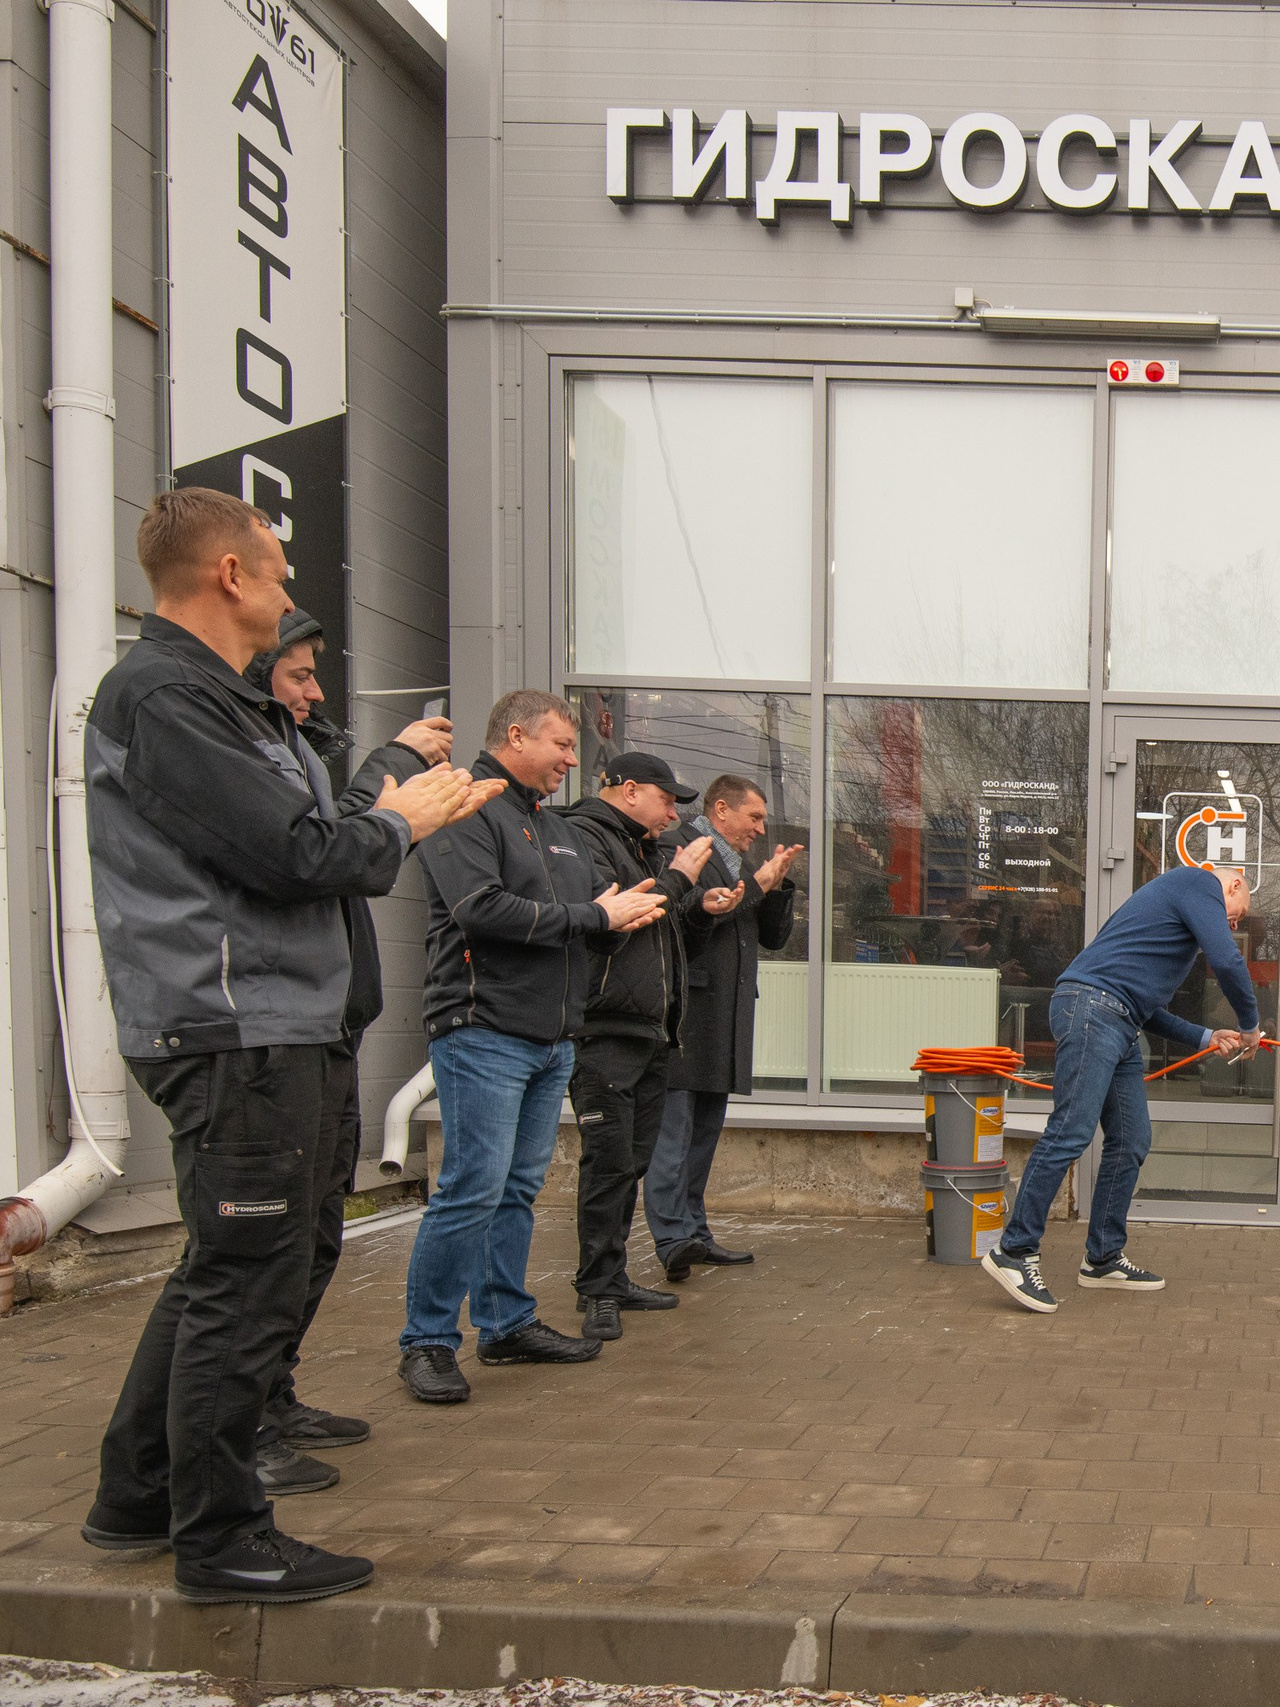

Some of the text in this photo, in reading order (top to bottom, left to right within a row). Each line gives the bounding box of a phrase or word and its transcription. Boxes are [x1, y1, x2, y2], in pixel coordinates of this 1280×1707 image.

[981, 780, 1060, 791] ООО «ГИДРОСКАНД»
[979, 807, 992, 816] Пн
[979, 815, 990, 824] Вт
[978, 824, 991, 834] Ср
[1005, 825, 1026, 834] 8-00
[1033, 826, 1059, 835] 18-00
[978, 832, 990, 841] Чт
[978, 840, 990, 849] Пт
[978, 852, 991, 861] Сб
[978, 861, 990, 869] Вс
[1004, 858, 1052, 867] выходной
[226, 1203, 286, 1213] HYDROSCAND
